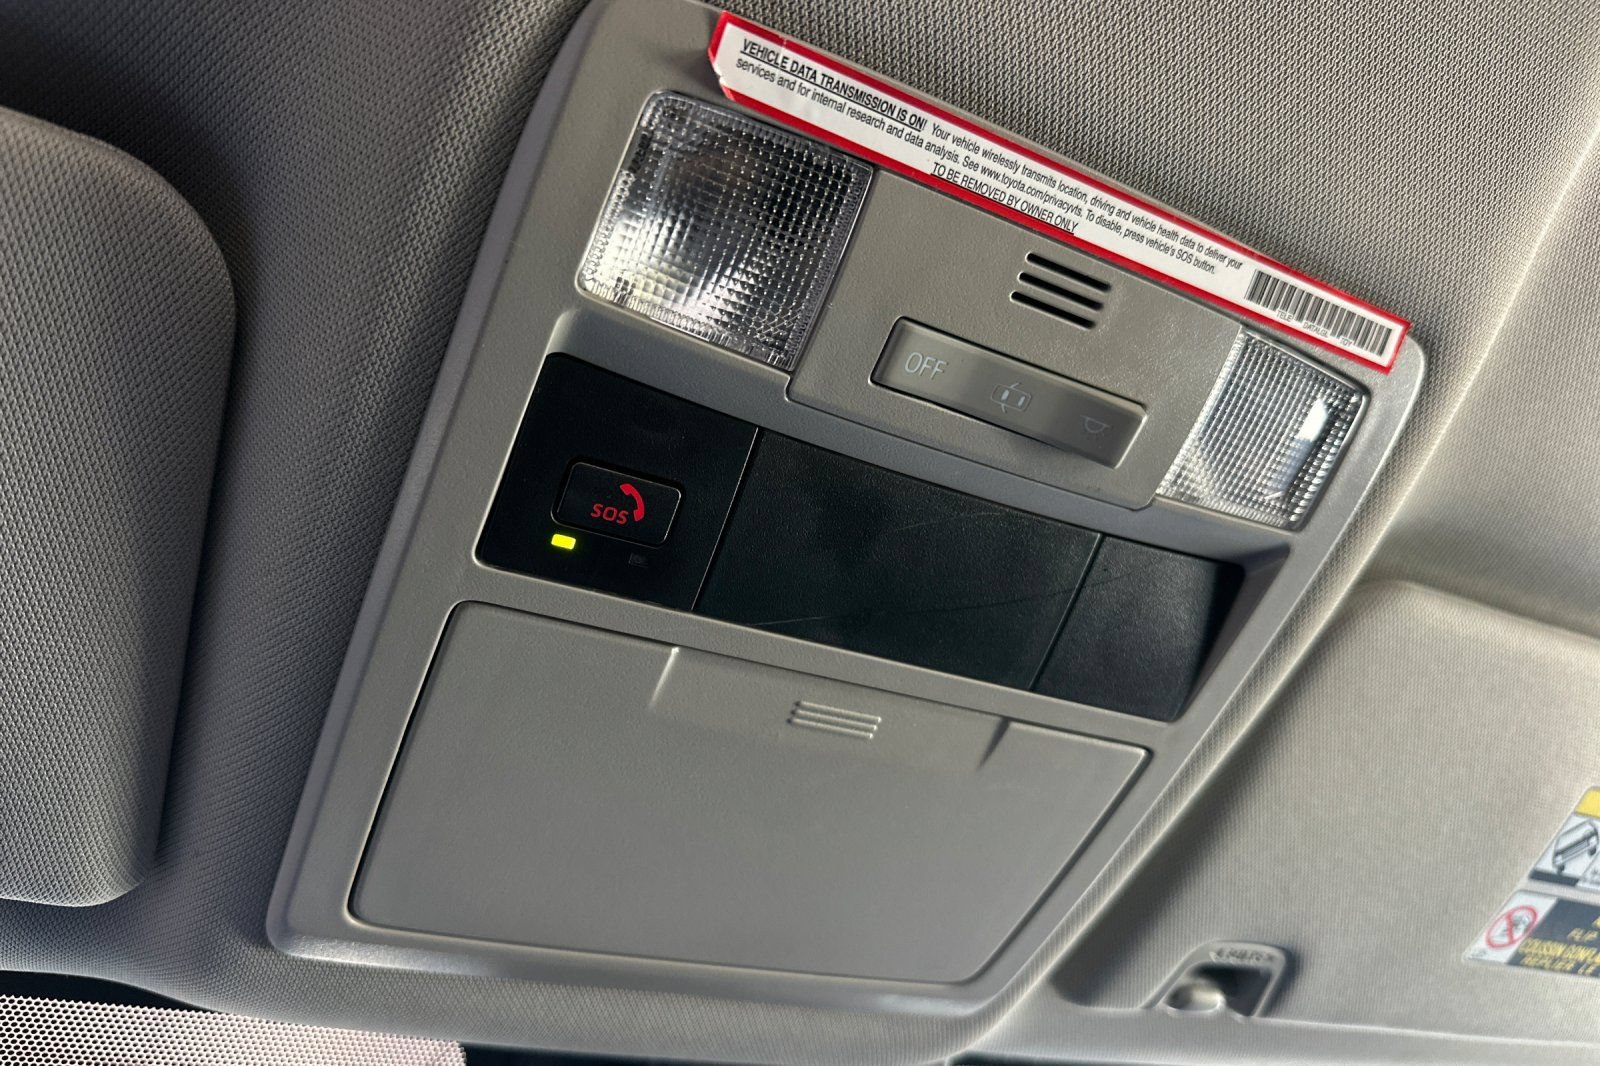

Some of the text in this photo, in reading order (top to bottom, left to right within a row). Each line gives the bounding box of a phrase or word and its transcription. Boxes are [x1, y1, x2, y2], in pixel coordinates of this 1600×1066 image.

[735, 57, 775, 82] services
[777, 73, 795, 91] and
[796, 81, 811, 97] for
[811, 88, 846, 111] internal
[847, 104, 885, 131] research
[887, 122, 904, 139] and
[904, 130, 923, 147] data
[925, 140, 959, 165] analysis.
[962, 156, 979, 171] See
[1086, 209, 1095, 222] To
[1095, 216, 1122, 235] disable,
[1123, 227, 1144, 244] press
[1145, 237, 1175, 257] vehicle's
[1175, 250, 1193, 264] SOS
[1193, 255, 1215, 274] button.
[742, 38, 1243, 270] VEHICLE DATA TRANSMISSION IS ON! Your vehicle wirelessly transmits location, driving and vehicle health data to deliver your
[932, 162, 1078, 234] TO BE REMOVED BY OWNER ONLY
[904, 352, 948, 380] OFF
[591, 503, 629, 525] SOS
